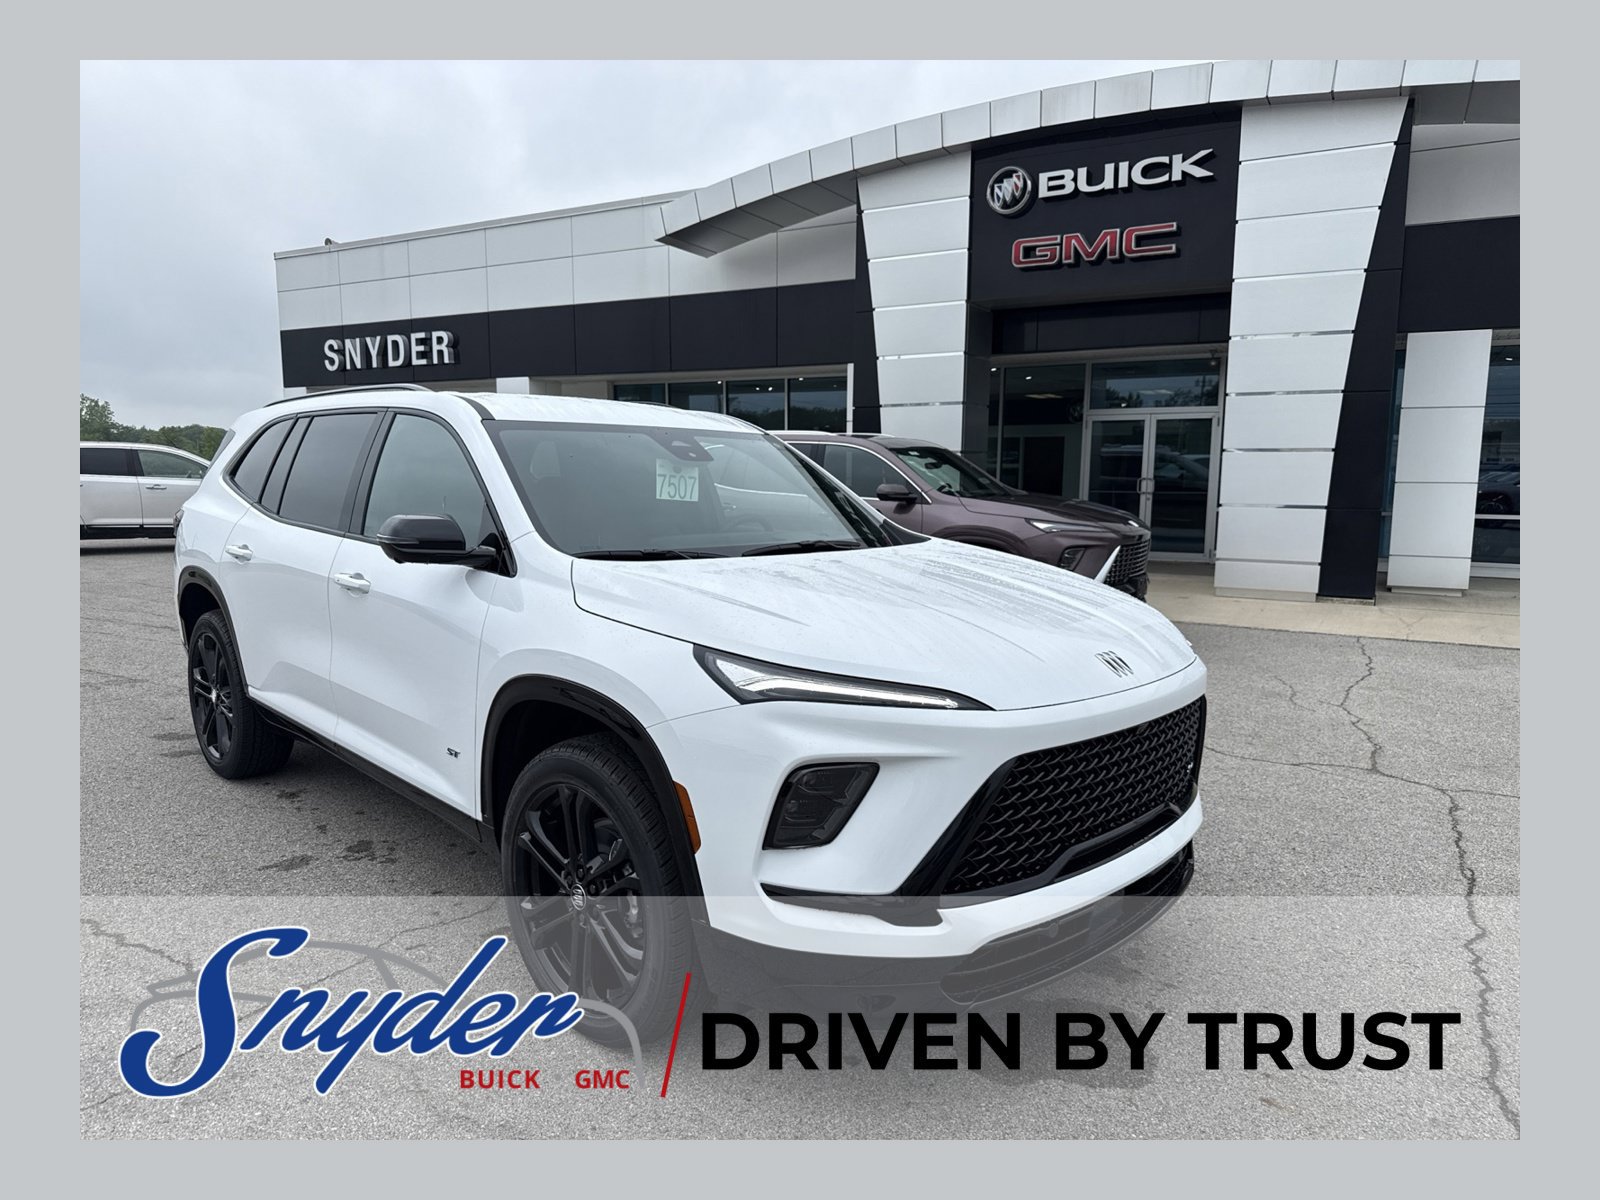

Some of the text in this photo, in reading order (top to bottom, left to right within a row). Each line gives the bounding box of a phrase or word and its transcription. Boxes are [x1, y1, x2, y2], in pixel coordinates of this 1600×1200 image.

[1038, 148, 1214, 199] BUICK
[1011, 222, 1177, 268] GMC
[323, 330, 453, 372] SNYDER
[657, 473, 697, 500] 7507
[446, 747, 461, 759] ST
